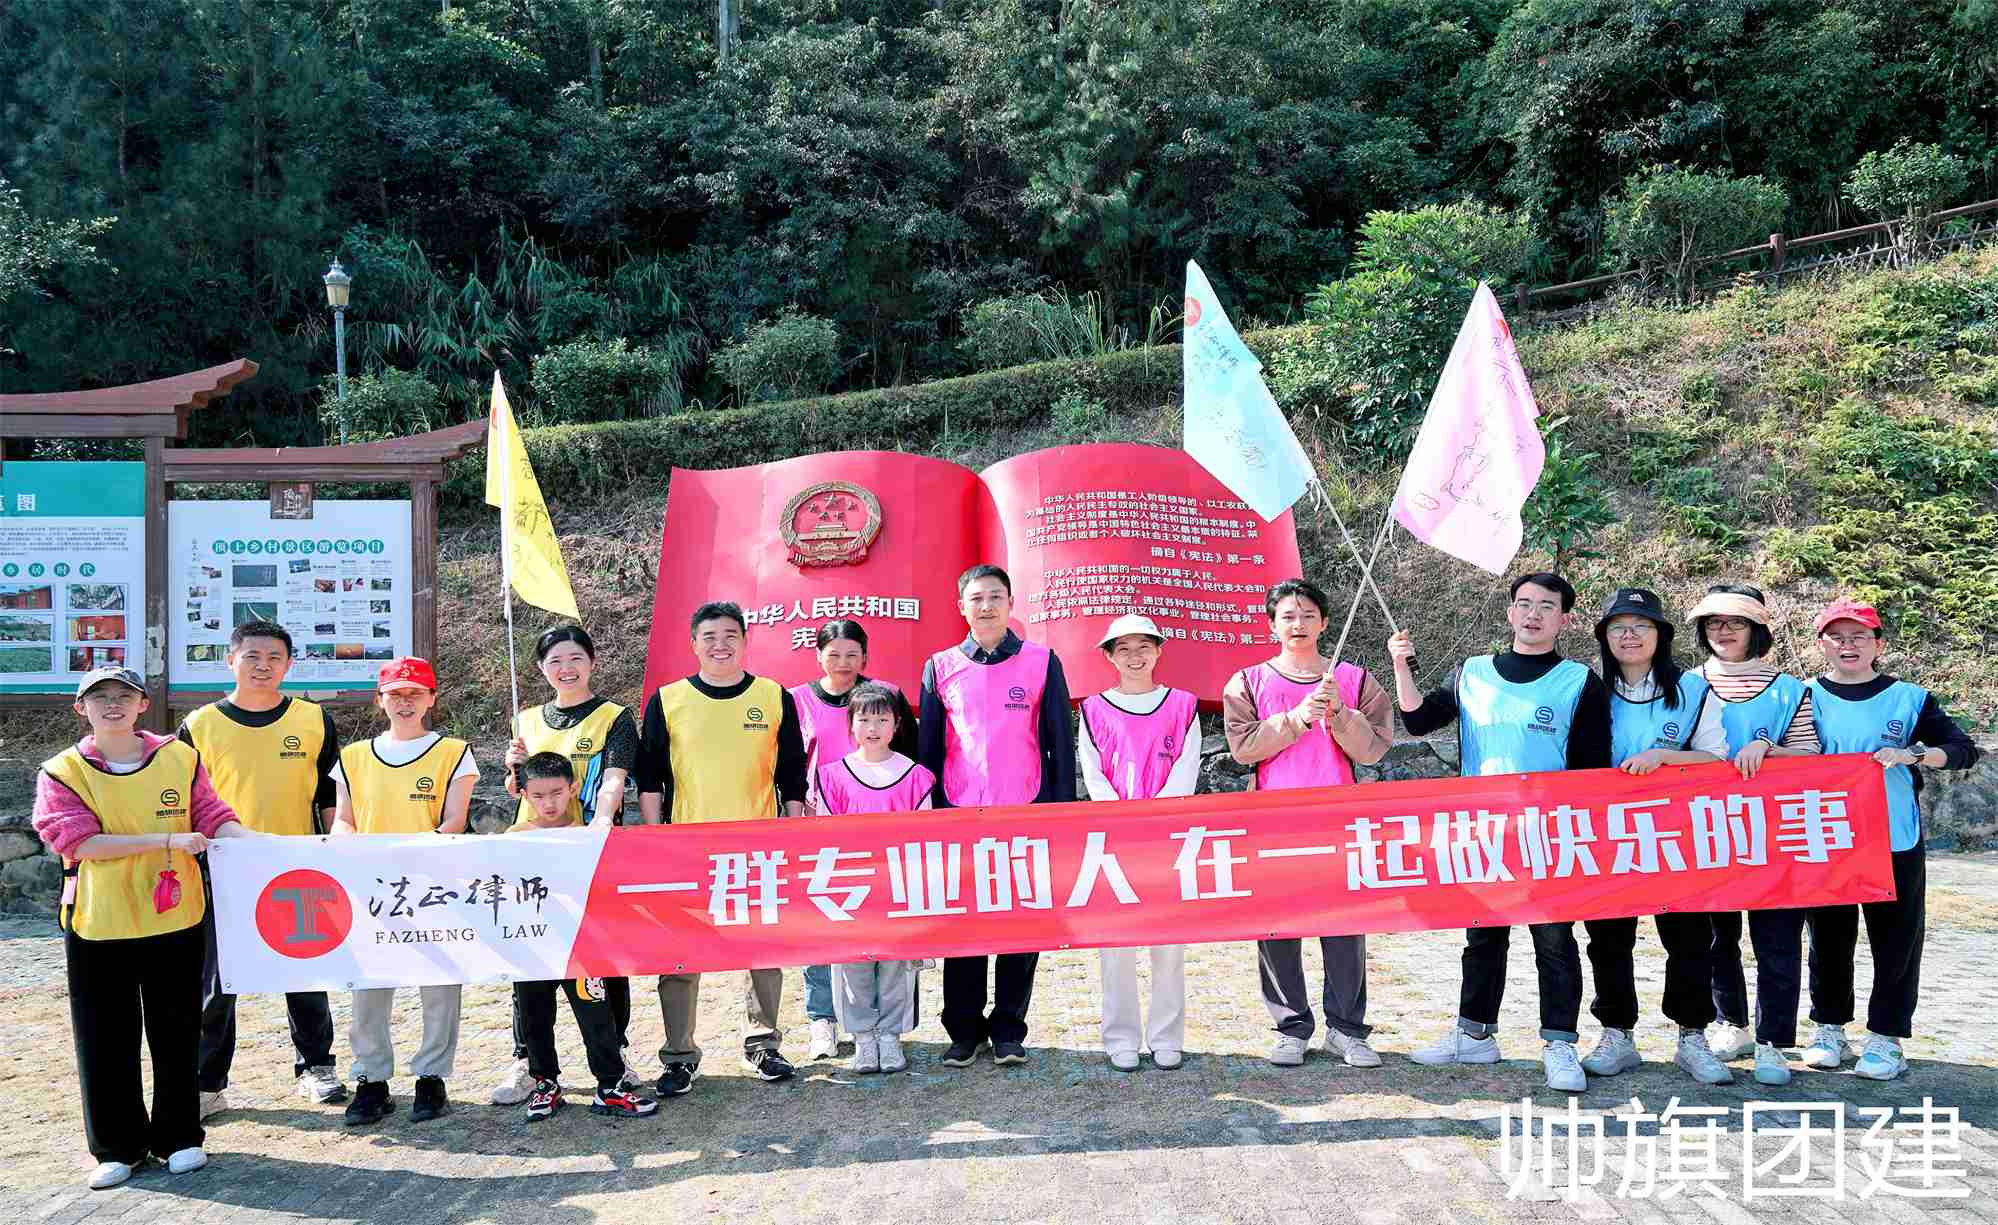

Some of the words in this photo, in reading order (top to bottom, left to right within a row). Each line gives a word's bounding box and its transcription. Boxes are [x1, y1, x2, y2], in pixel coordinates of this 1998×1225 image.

[743, 596, 920, 629] 中华人民共和国
[617, 833, 1140, 928] 一群专业的人
[1172, 789, 1854, 901] 在一起做快乐的事
[375, 928, 475, 944] FAZHENG
[503, 924, 548, 939] LAW
